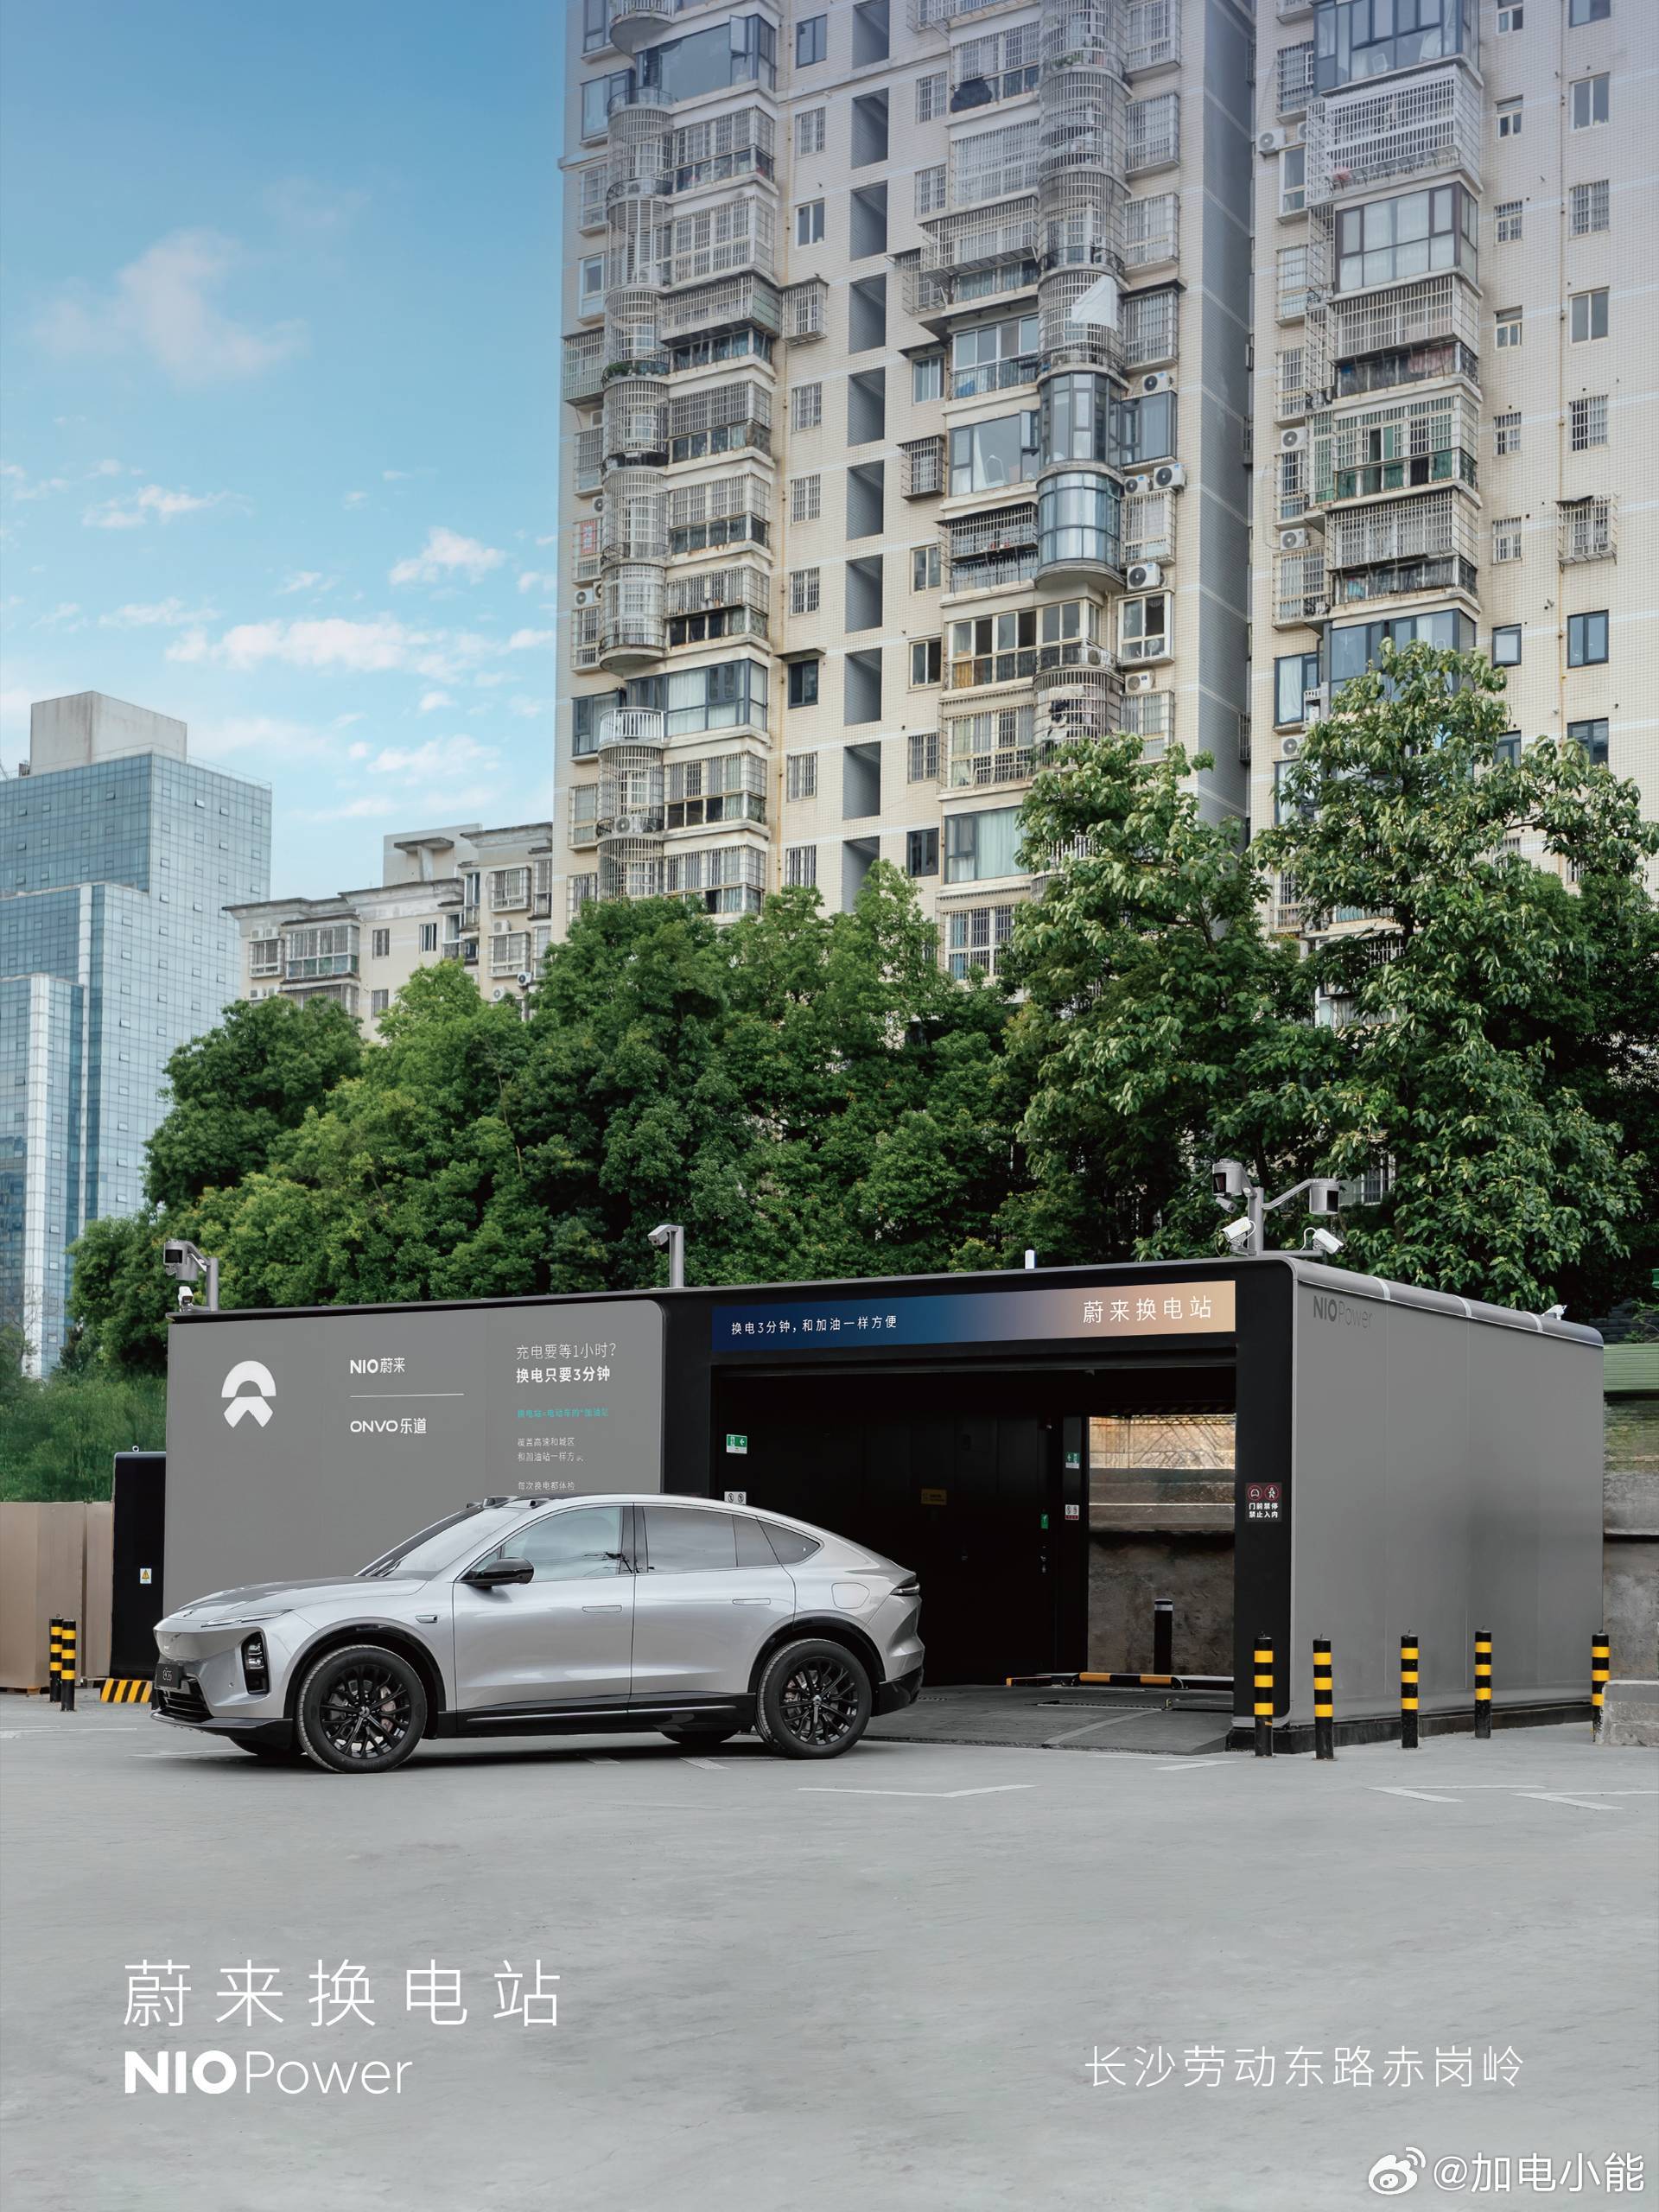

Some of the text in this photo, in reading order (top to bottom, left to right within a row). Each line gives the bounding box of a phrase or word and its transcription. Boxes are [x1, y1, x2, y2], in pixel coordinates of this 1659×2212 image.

[1083, 1295, 1212, 1324] 蔚来换电站
[516, 1364, 611, 1383] 换电只要3分钟
